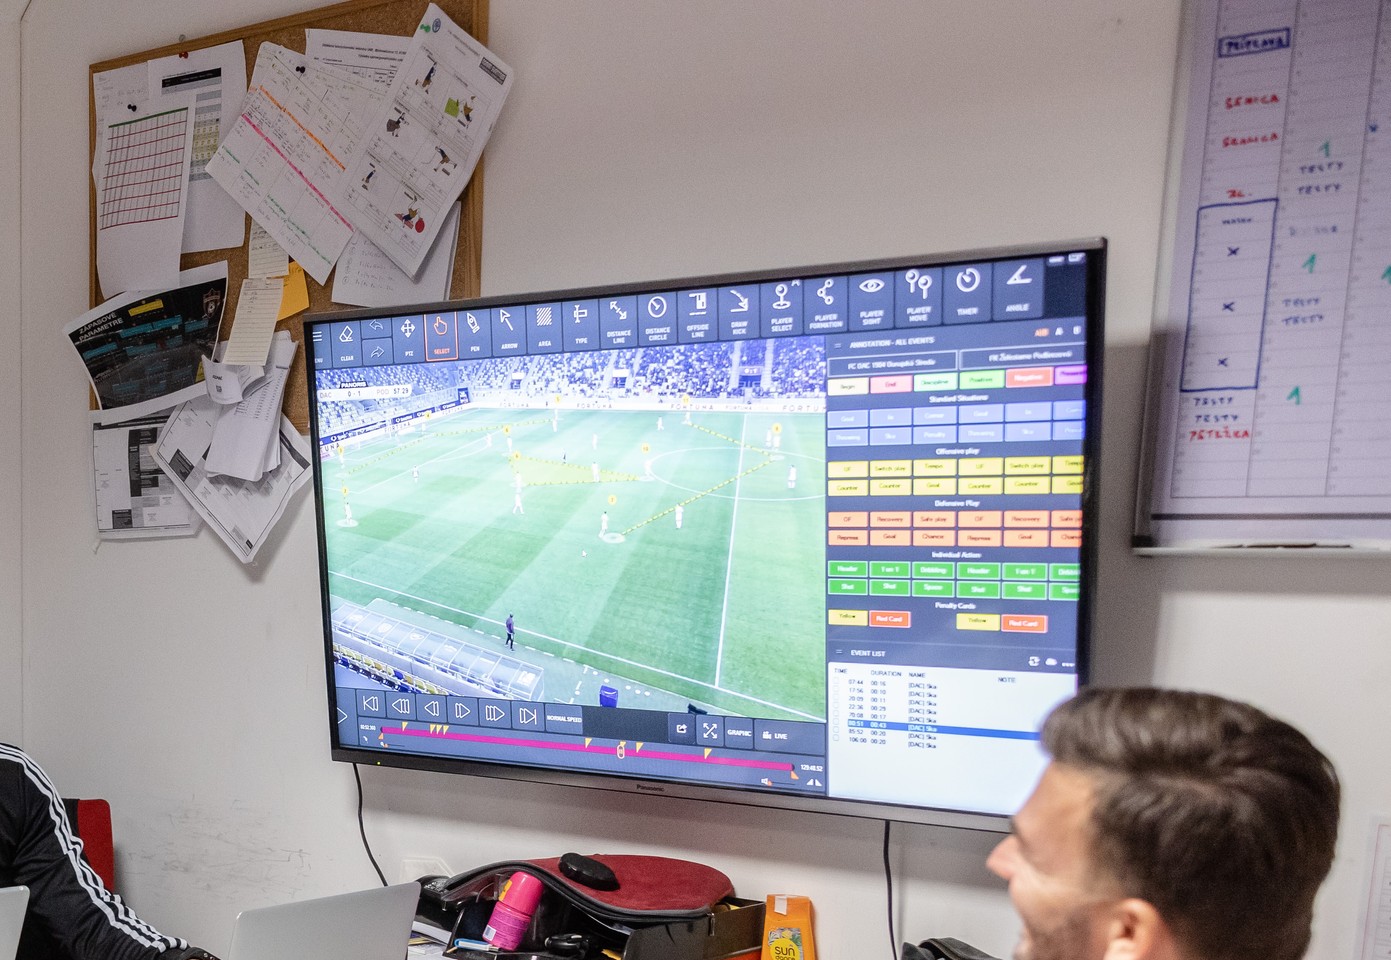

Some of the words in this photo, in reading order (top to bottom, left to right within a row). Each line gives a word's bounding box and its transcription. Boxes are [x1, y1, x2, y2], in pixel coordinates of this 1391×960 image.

[907, 306, 931, 314] PLAYER
[1006, 304, 1030, 312] ANGLE
[860, 310, 884, 318] PLAYER
[771, 317, 793, 325] PLAYER
